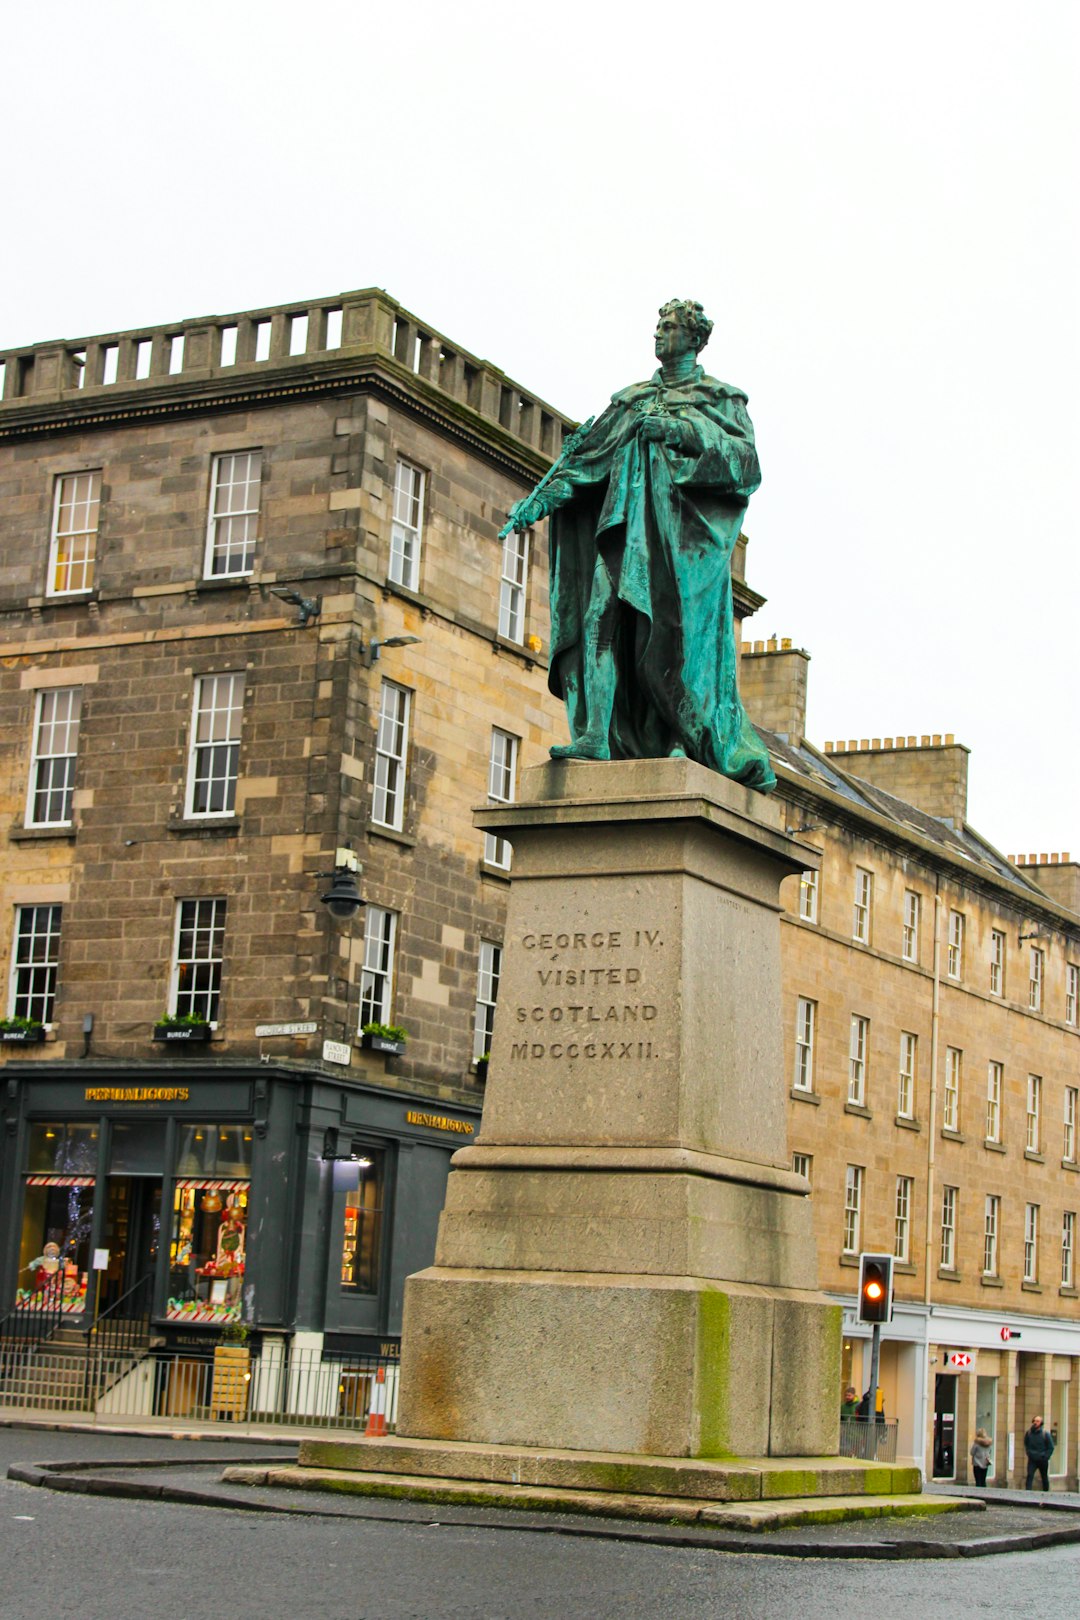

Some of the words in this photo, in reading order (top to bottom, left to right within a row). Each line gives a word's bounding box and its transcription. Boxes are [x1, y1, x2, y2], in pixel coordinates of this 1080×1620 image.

[521, 931, 622, 951] GEORGE
[634, 930, 664, 947] IV.
[536, 967, 642, 987] VISITED
[516, 1004, 659, 1023] SCOTLAND
[257, 1025, 286, 1035] GEORGE
[289, 1023, 315, 1033] STREET
[327, 1051, 346, 1061] STREET
